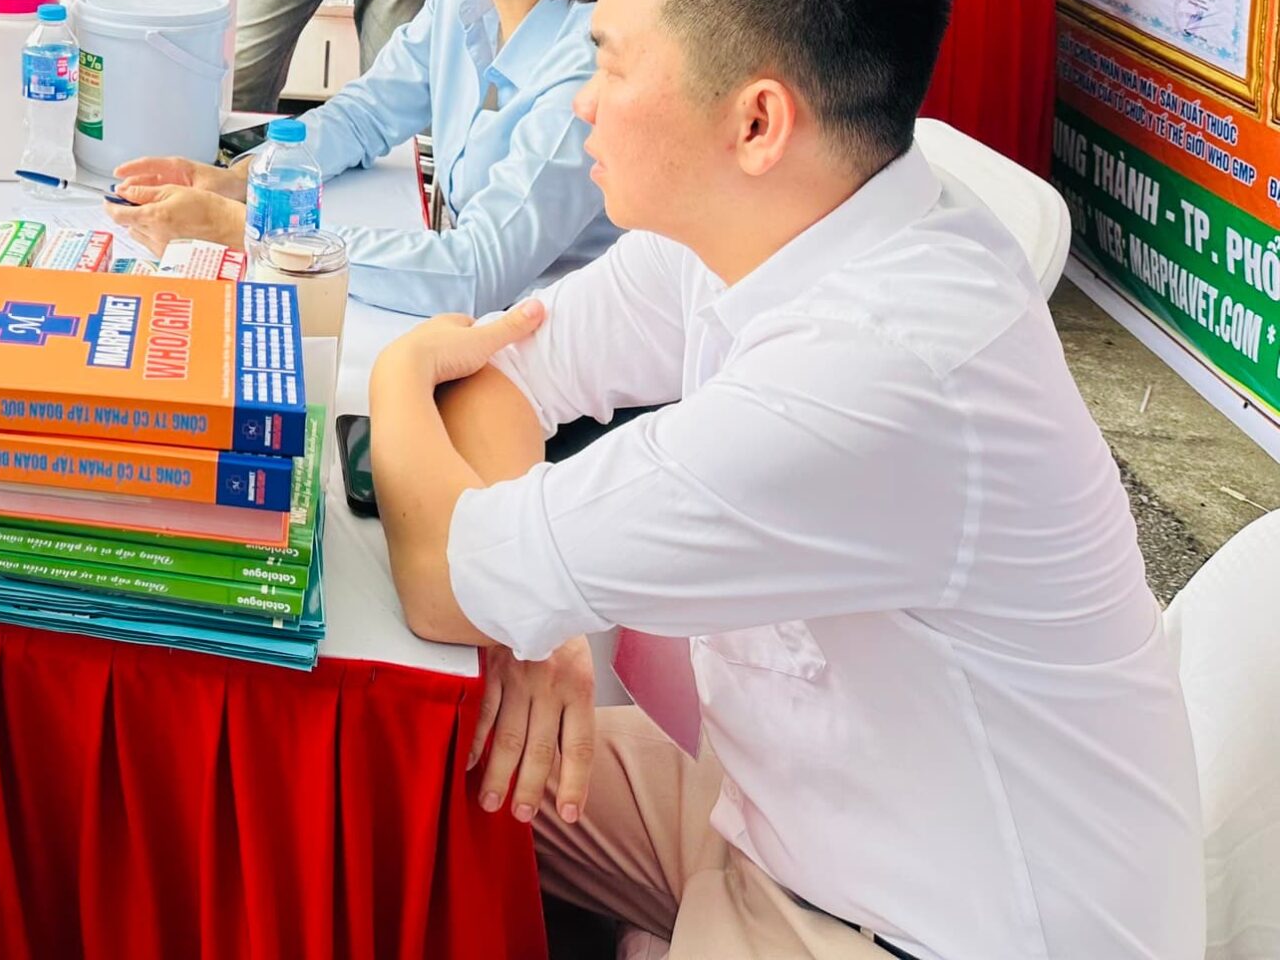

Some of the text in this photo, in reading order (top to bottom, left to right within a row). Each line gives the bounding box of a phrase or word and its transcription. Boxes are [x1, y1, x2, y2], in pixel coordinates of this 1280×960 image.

[1140, 76, 1158, 101] MÁY
[1160, 84, 1178, 113] SẢN
[1179, 100, 1204, 127] XUẤT
[1206, 114, 1239, 145] THUỐC
[1126, 98, 1146, 125] CHỨC
[1155, 113, 1167, 137] TẾ
[1167, 120, 1185, 146] THẾ
[1186, 130, 1206, 158] GIỚI
[1206, 144, 1230, 174] WHO
[1231, 159, 1257, 187] GMP
[1092, 143, 1160, 226] THÀNH
[1129, 233, 1263, 364] MARPHAVET.COM
[92, 296, 140, 366] MARPHAVET
[143, 292, 192, 380] WHO/GMP
[0, 401, 24, 422] ĐỨC
[30, 403, 63, 425] ĐOÀN
[68, 405, 91, 426] TẬP
[154, 412, 168, 428] TY
[173, 415, 207, 433] CÔNG
[138, 465, 152, 481] TY
[156, 467, 191, 488] CÔNG
[242, 567, 297, 586] Catalogue
[237, 595, 291, 614] Catalogue
